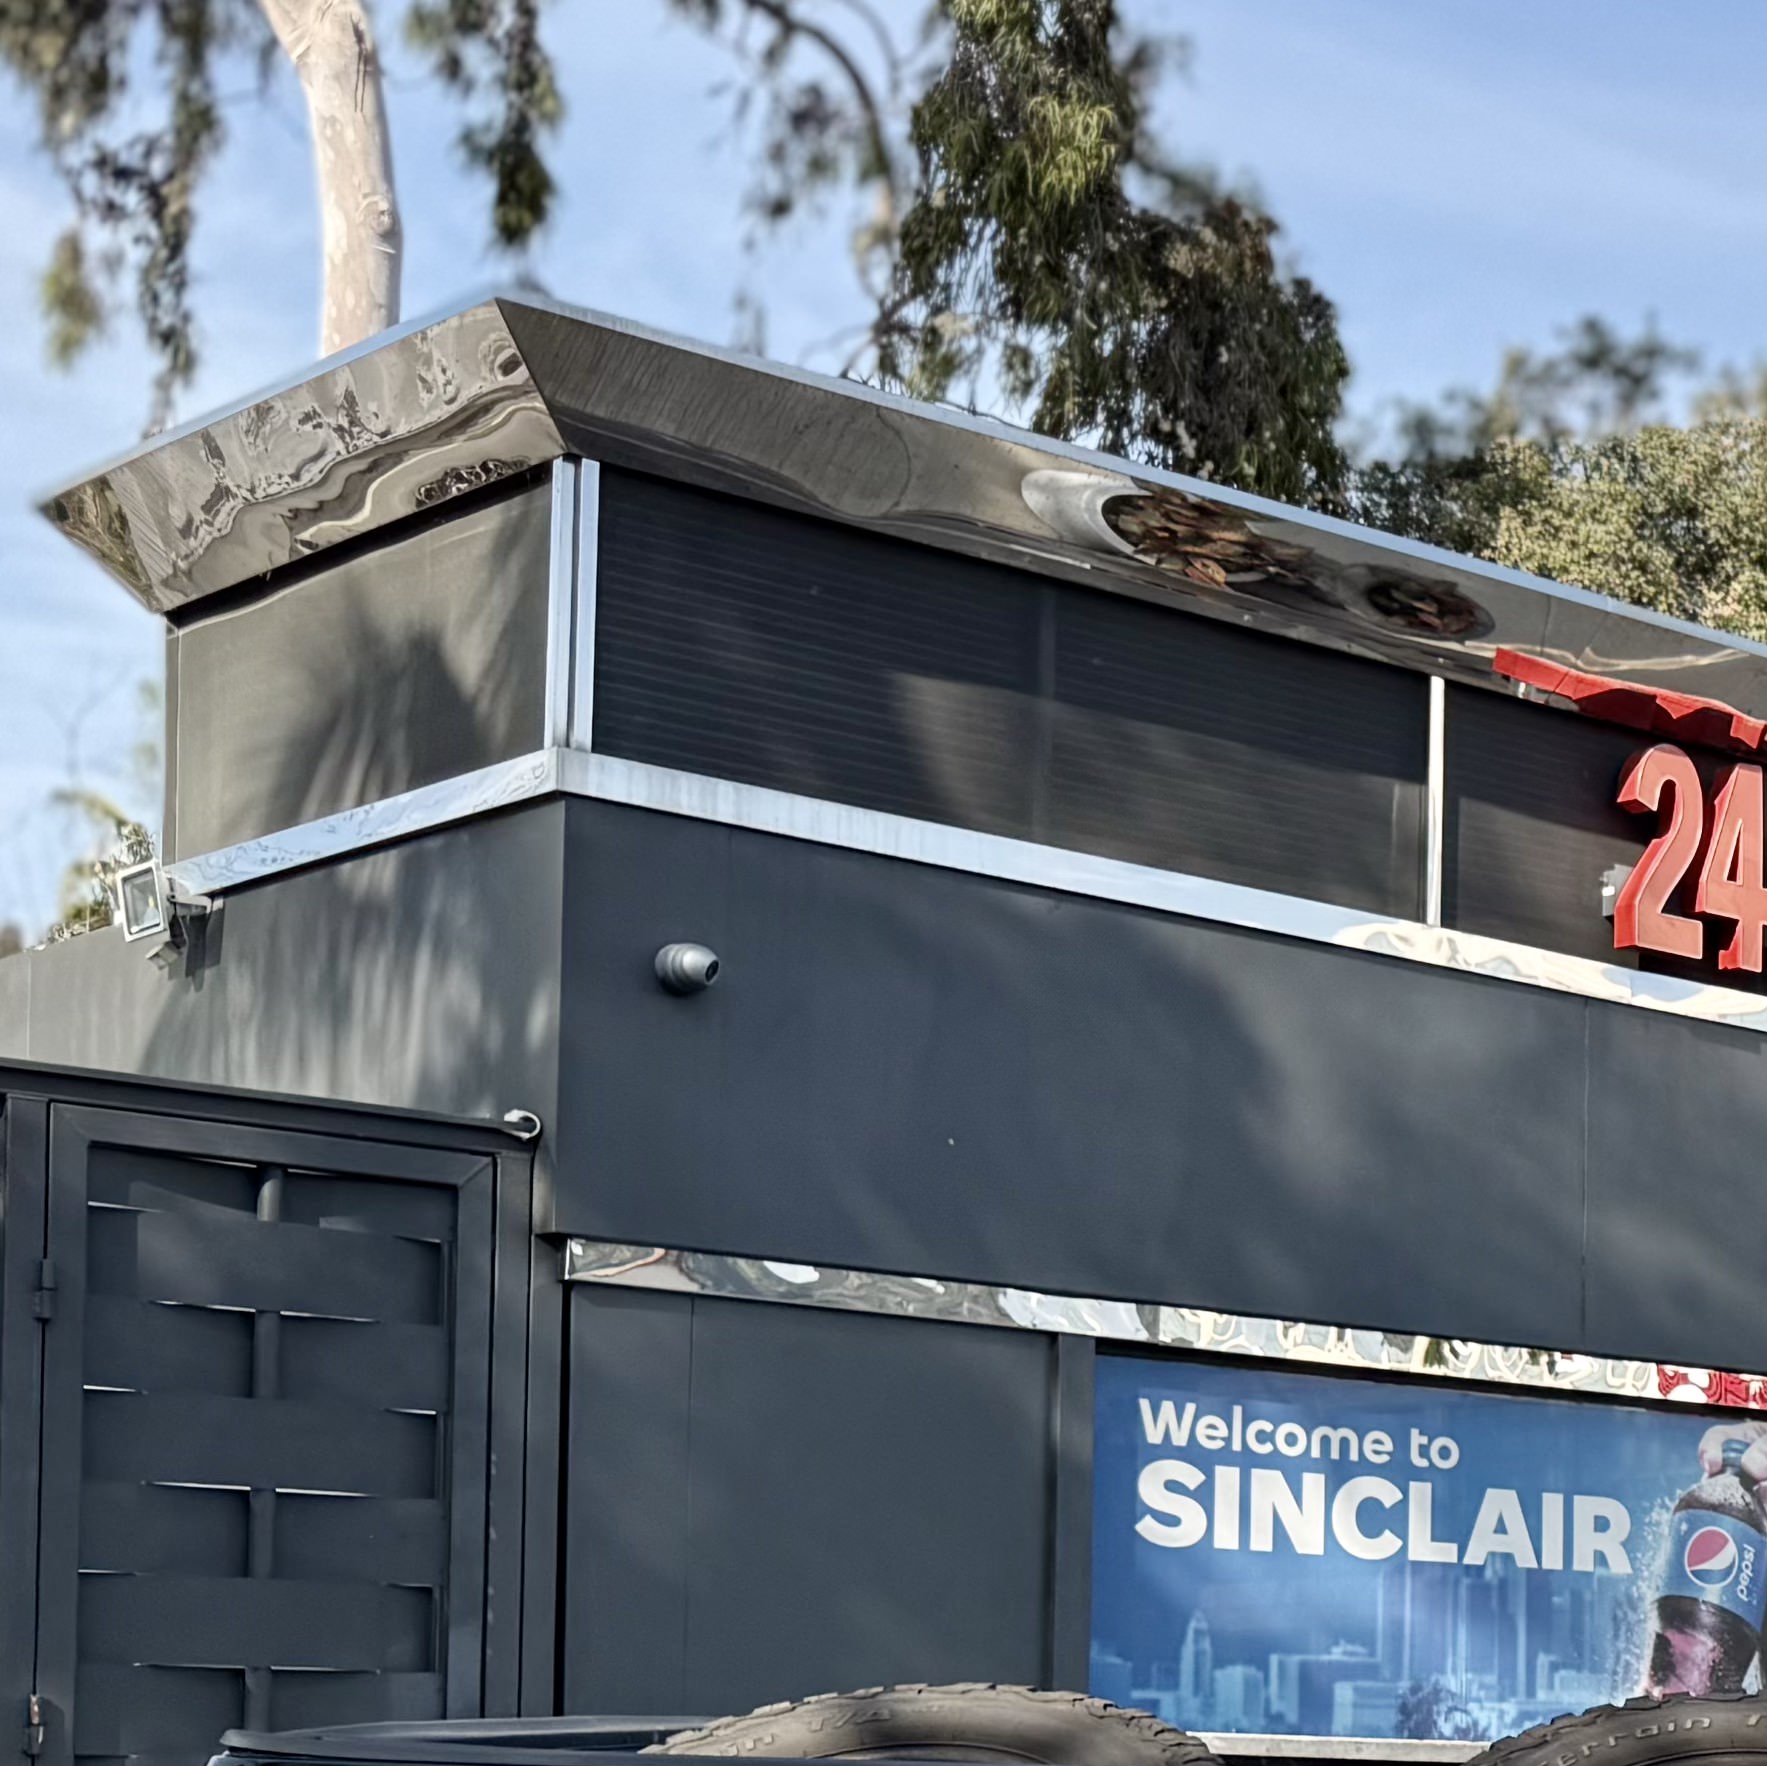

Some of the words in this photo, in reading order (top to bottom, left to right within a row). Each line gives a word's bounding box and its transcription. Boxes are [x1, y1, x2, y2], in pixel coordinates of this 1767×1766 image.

[1138, 1398, 1393, 1465] Welcome
[1410, 1428, 1460, 1470] to
[1134, 1459, 1633, 1574] SINCLAIR
[1737, 1544, 1756, 1601] pepsi
